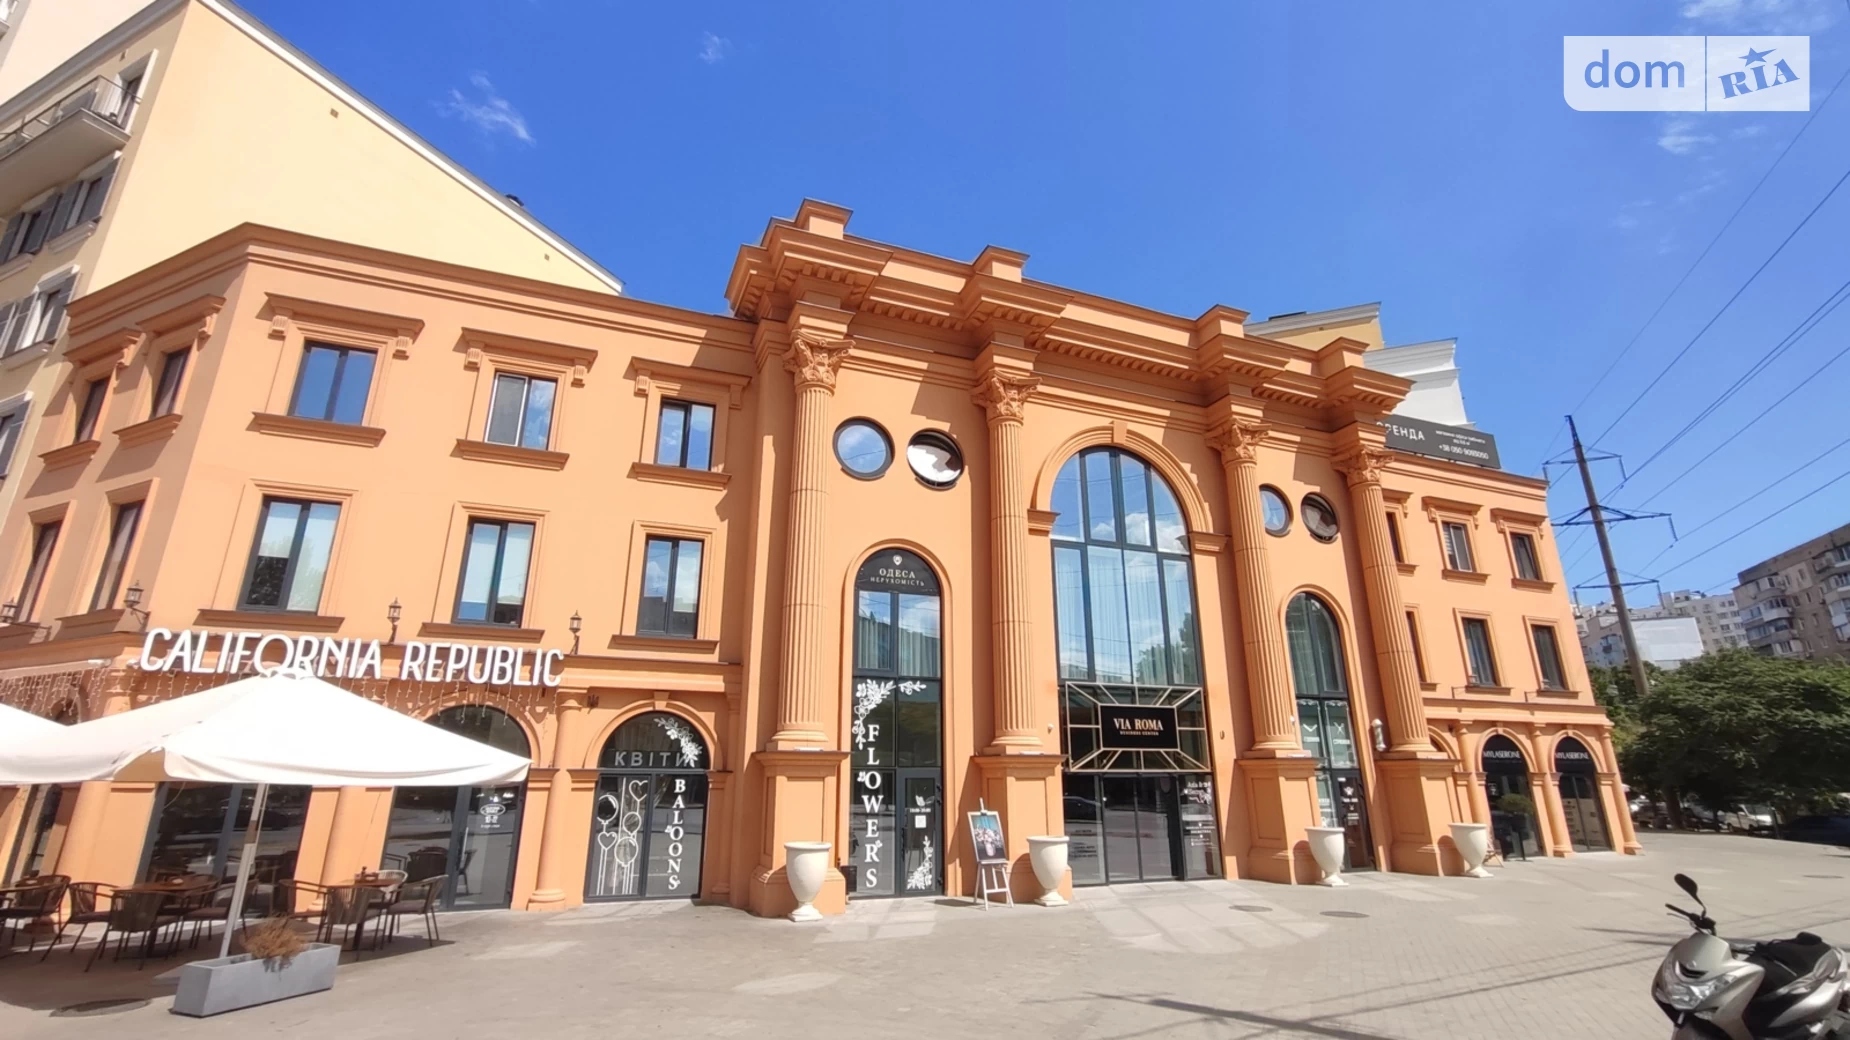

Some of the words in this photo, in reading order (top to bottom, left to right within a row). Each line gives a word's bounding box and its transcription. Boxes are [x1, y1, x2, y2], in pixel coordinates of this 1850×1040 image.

[879, 568, 916, 579] ОДЕСА
[140, 628, 381, 679] CALIFORNIA
[400, 641, 565, 687] REPUBLIC
[1113, 717, 1132, 730] VIA
[1134, 718, 1164, 731] ROMA
[667, 779, 686, 890] BALOONS
[861, 724, 885, 888] FLOWERS
